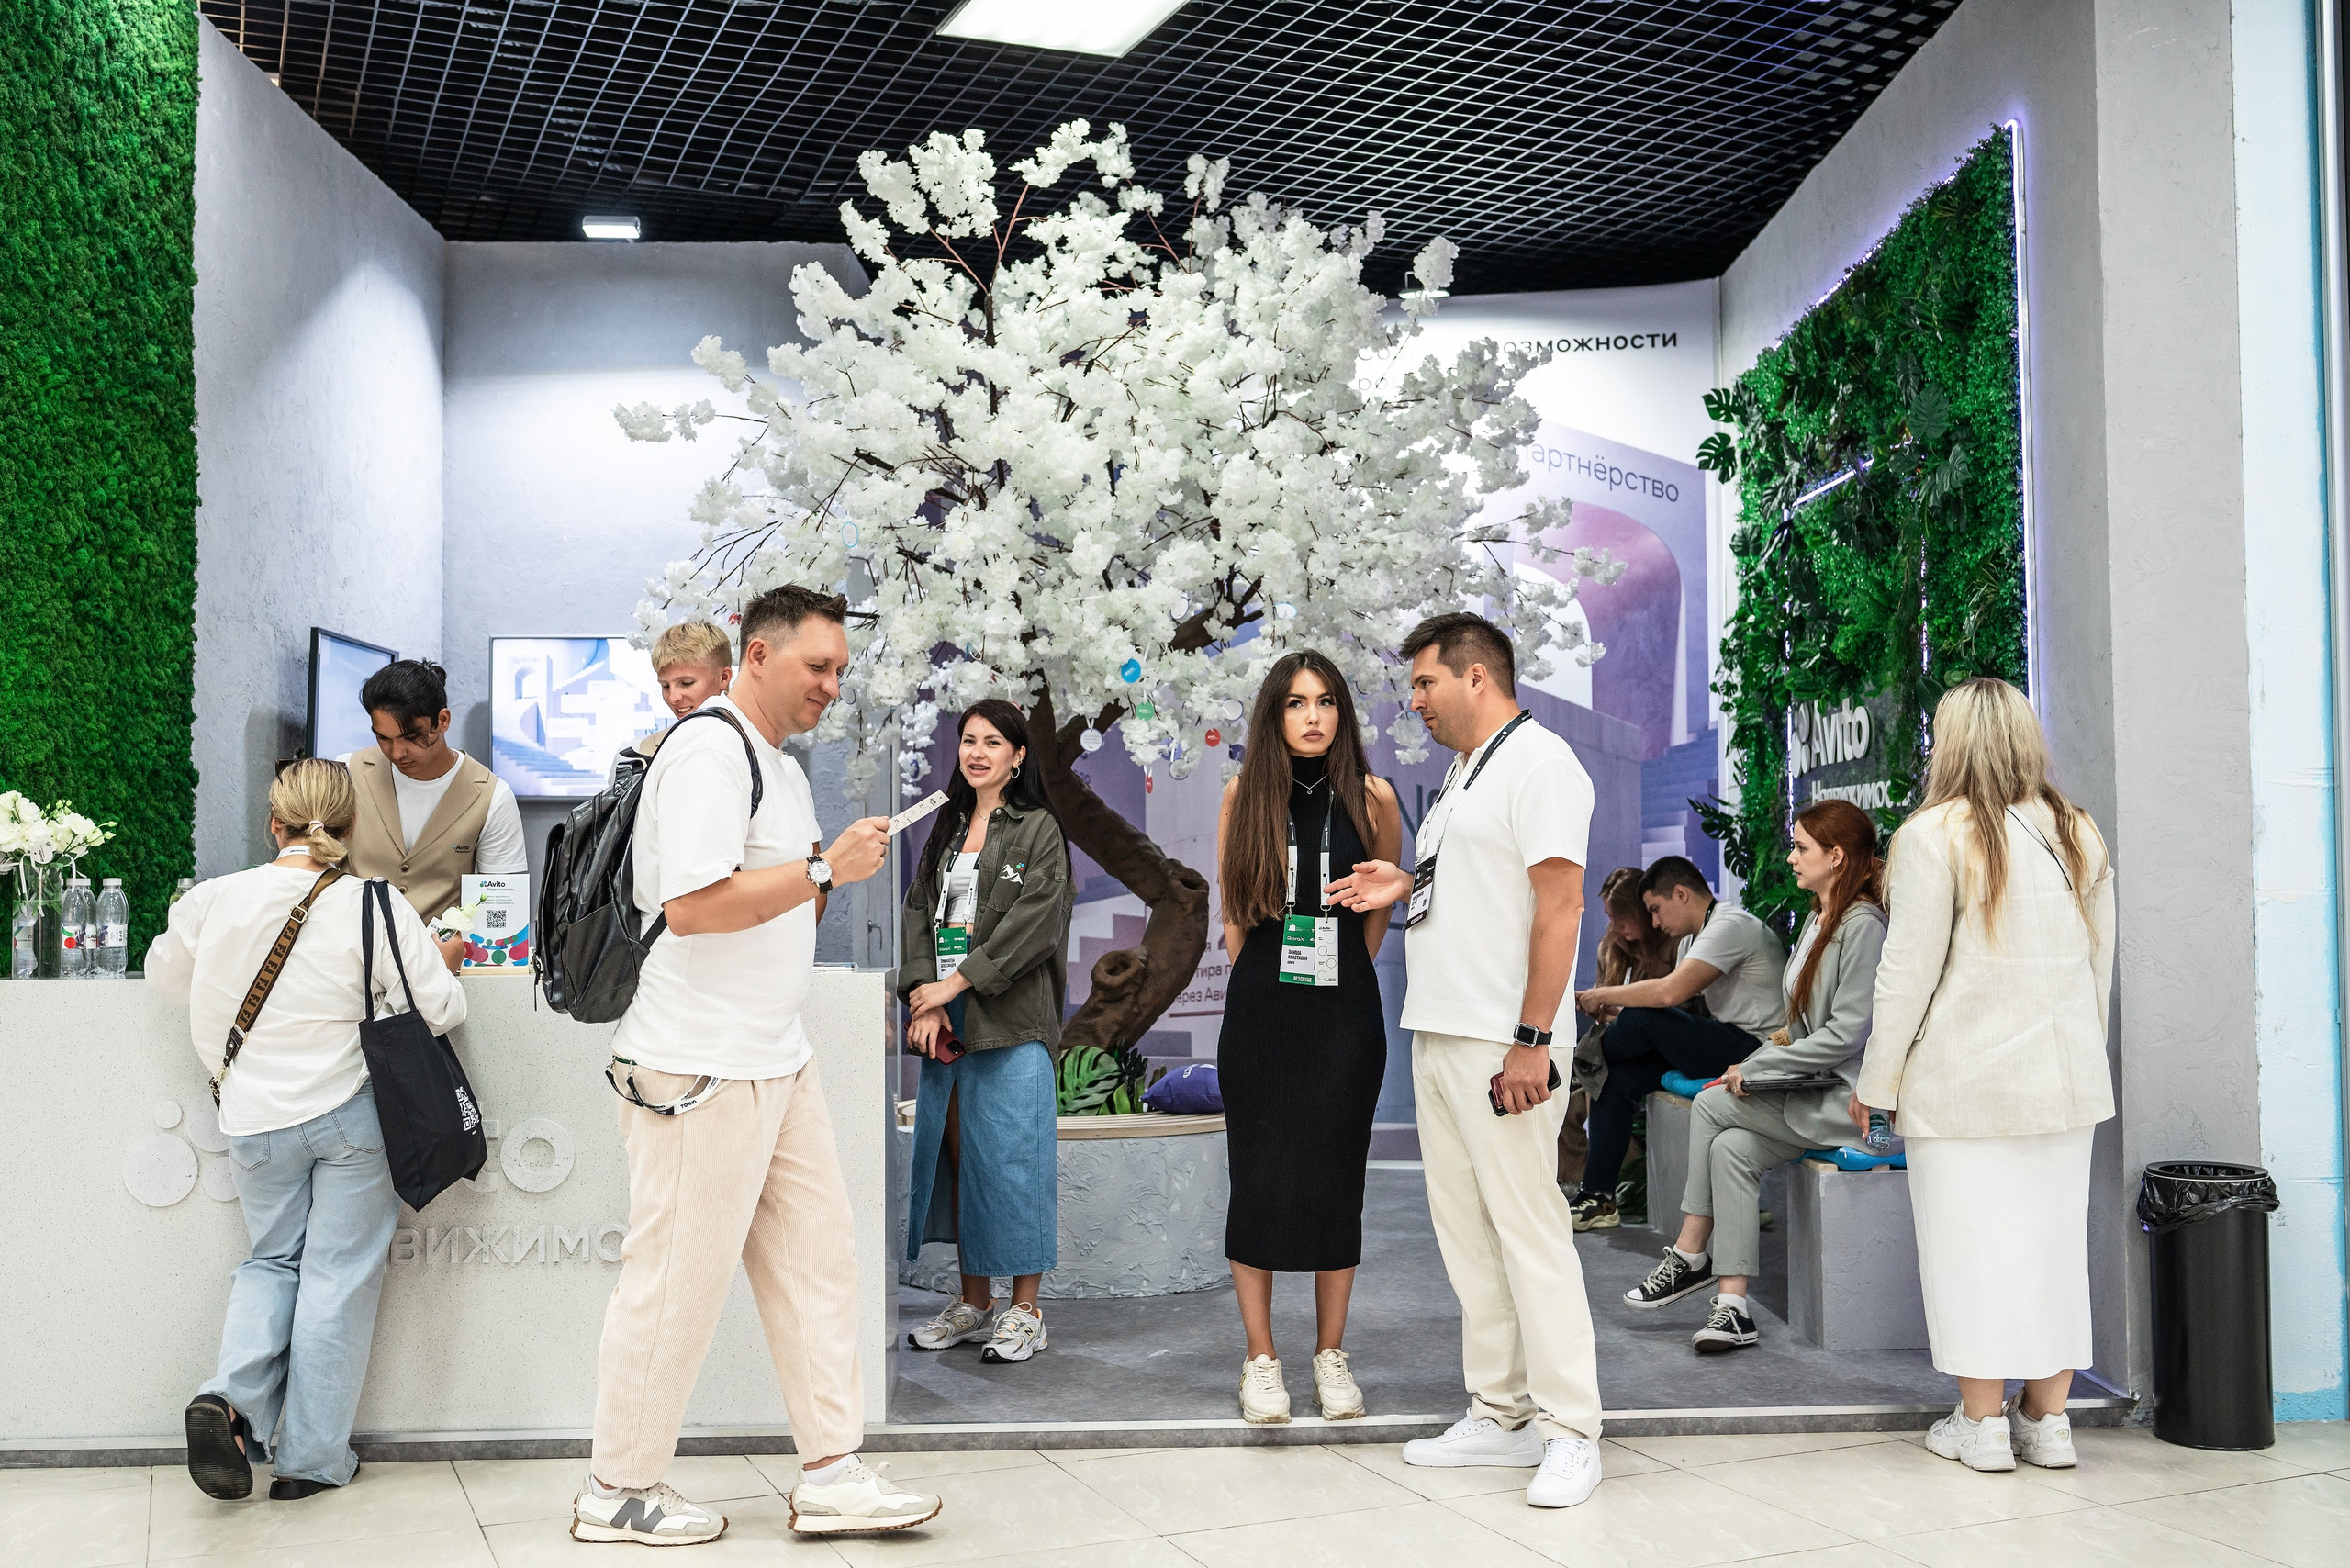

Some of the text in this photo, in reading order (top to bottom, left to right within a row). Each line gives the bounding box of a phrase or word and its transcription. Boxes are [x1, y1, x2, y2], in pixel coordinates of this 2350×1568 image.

[1504, 332, 1678, 354] озможности
[1811, 698, 1870, 769] Avito
[1176, 986, 1227, 1006] ерез Ави
